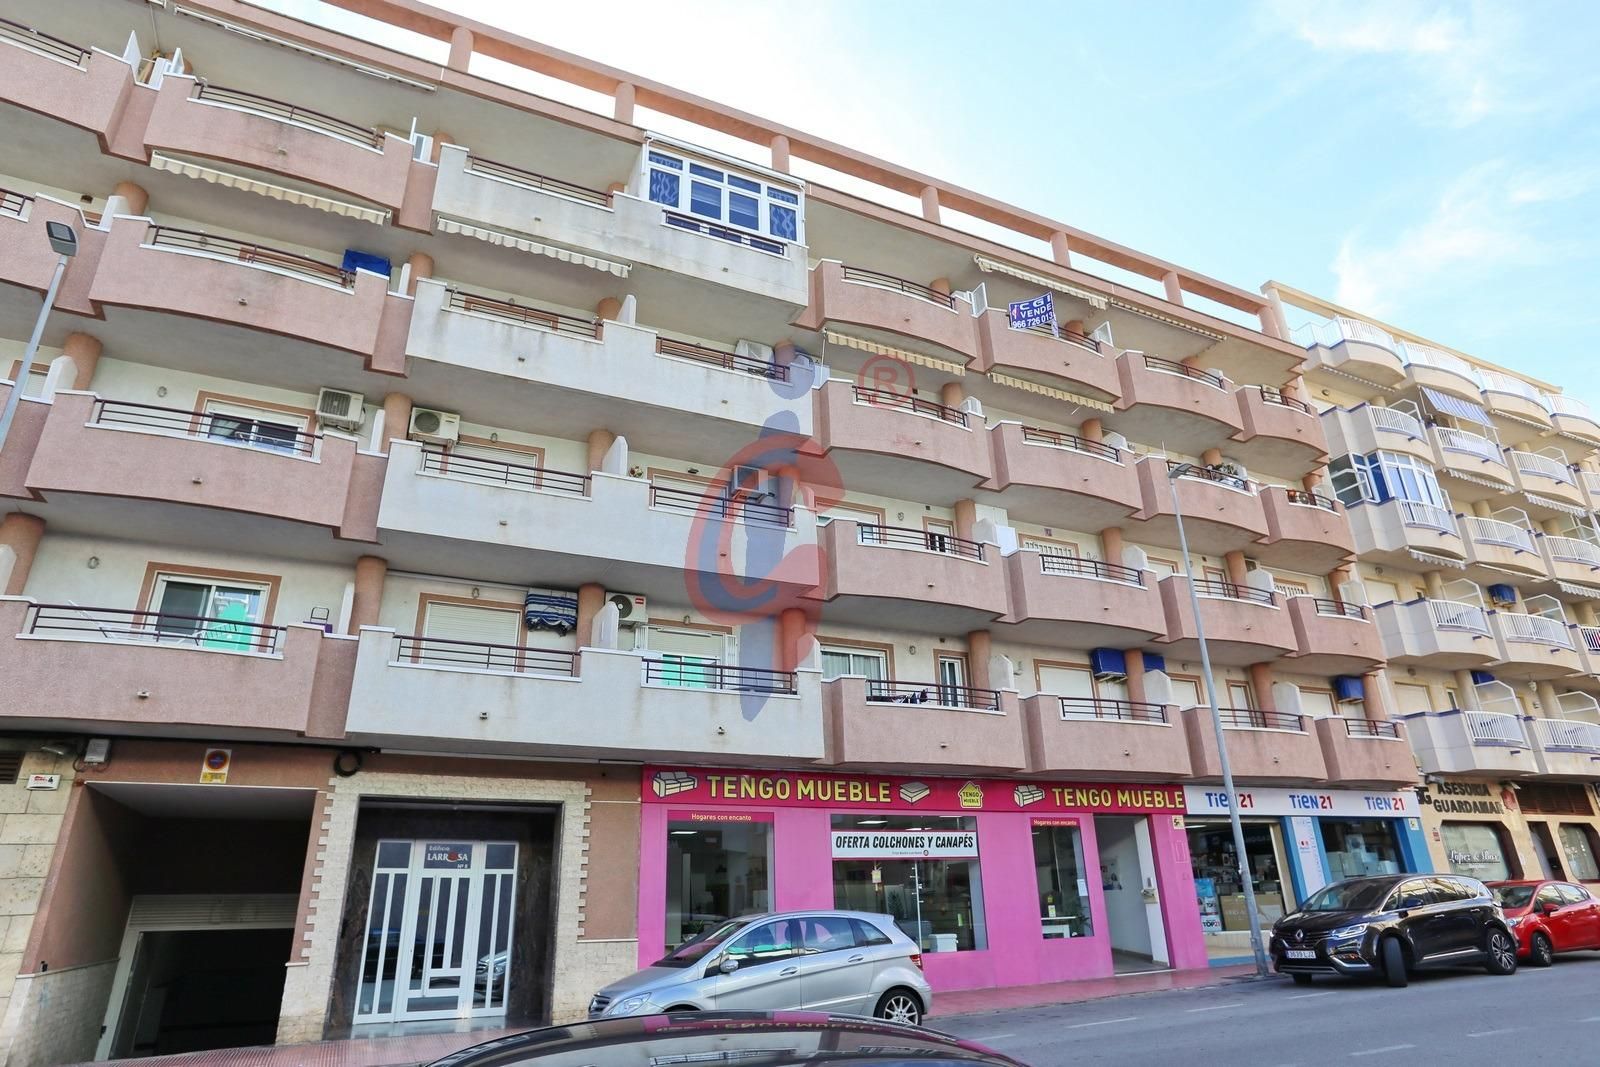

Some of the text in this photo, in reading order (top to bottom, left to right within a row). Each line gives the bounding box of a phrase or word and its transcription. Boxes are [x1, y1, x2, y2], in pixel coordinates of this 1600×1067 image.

[1020, 303, 1053, 318] VENDE
[1013, 311, 1053, 329] 966 726 013
[707, 775, 892, 803] TENGO MUEBLE
[1438, 783, 1491, 796] ASESORIA
[1052, 788, 1185, 809] TENGO MUEBLE
[1433, 799, 1504, 814] GUARDAMAR
[691, 813, 717, 821] Hogares
[835, 834, 974, 848] OFERTA COLCHONES Y CANAPÉS
